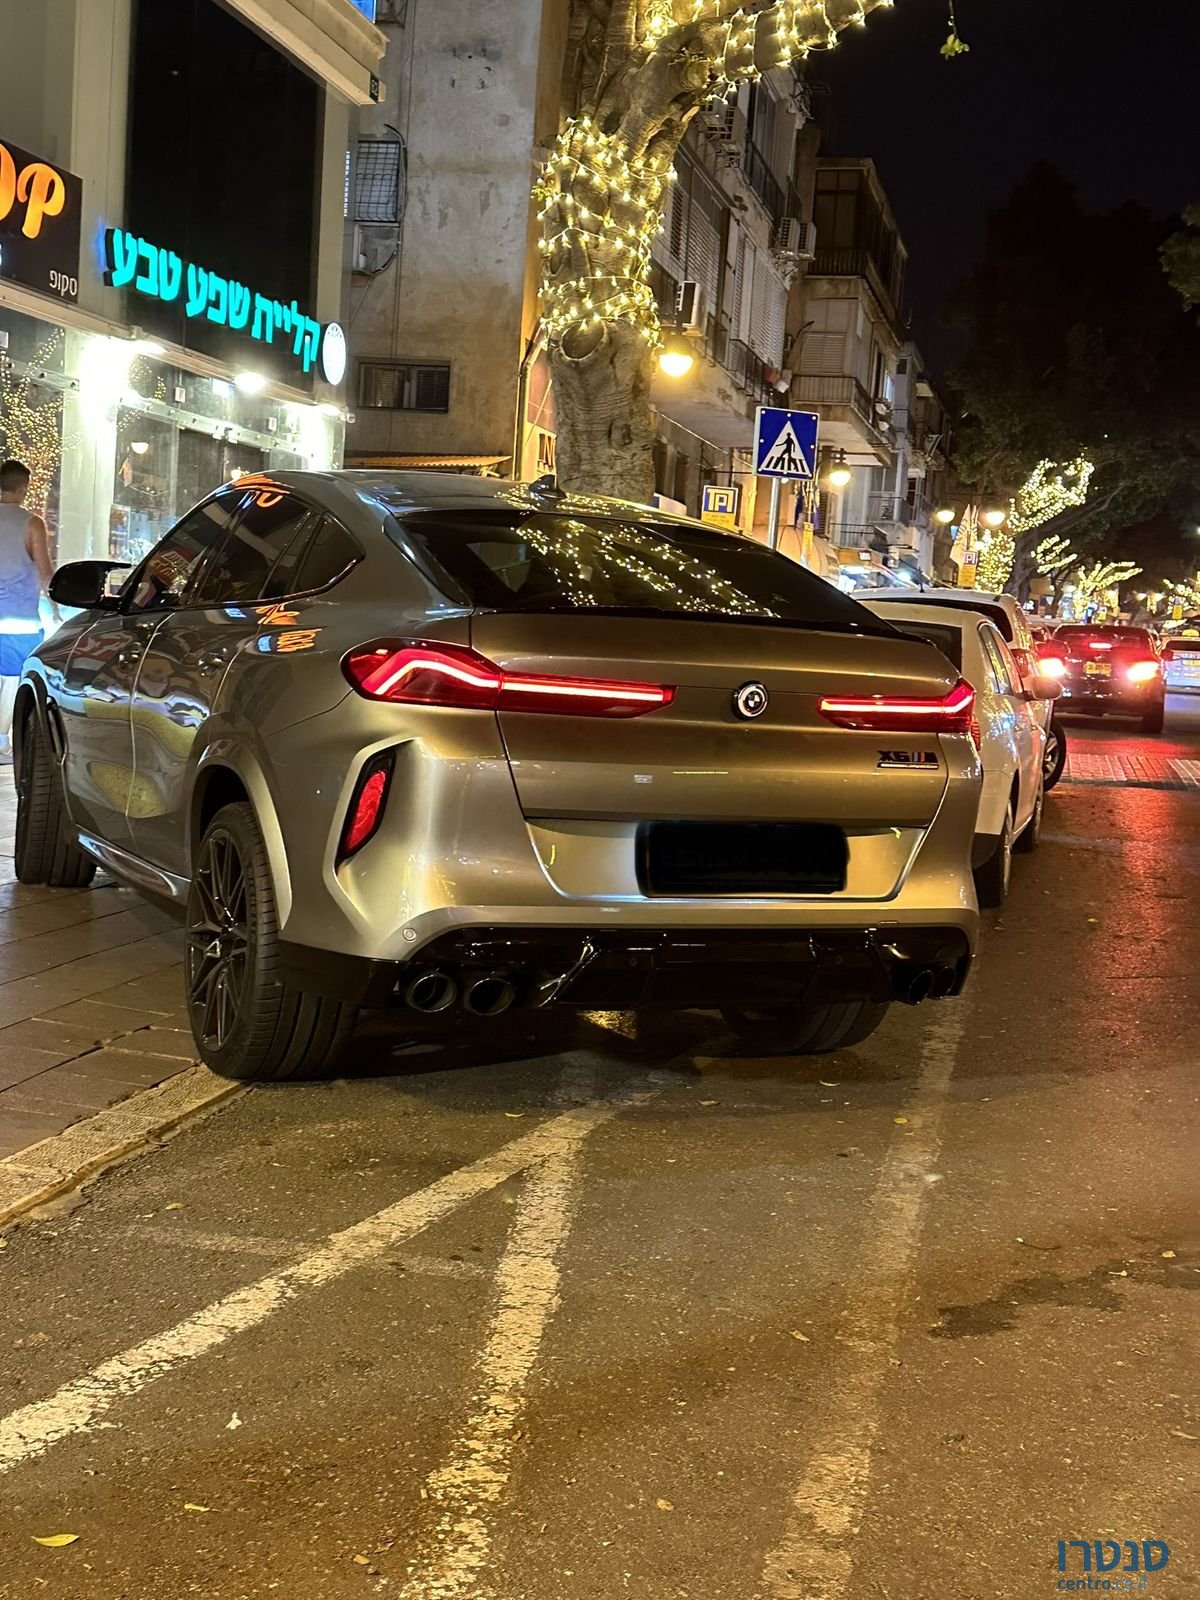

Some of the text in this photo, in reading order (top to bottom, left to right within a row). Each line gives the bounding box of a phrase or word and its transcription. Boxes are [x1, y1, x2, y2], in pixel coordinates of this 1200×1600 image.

[49, 269, 78, 297] סקופ
[111, 227, 182, 302] טבע
[185, 262, 250, 329] שפע
[249, 291, 321, 372] קליית
